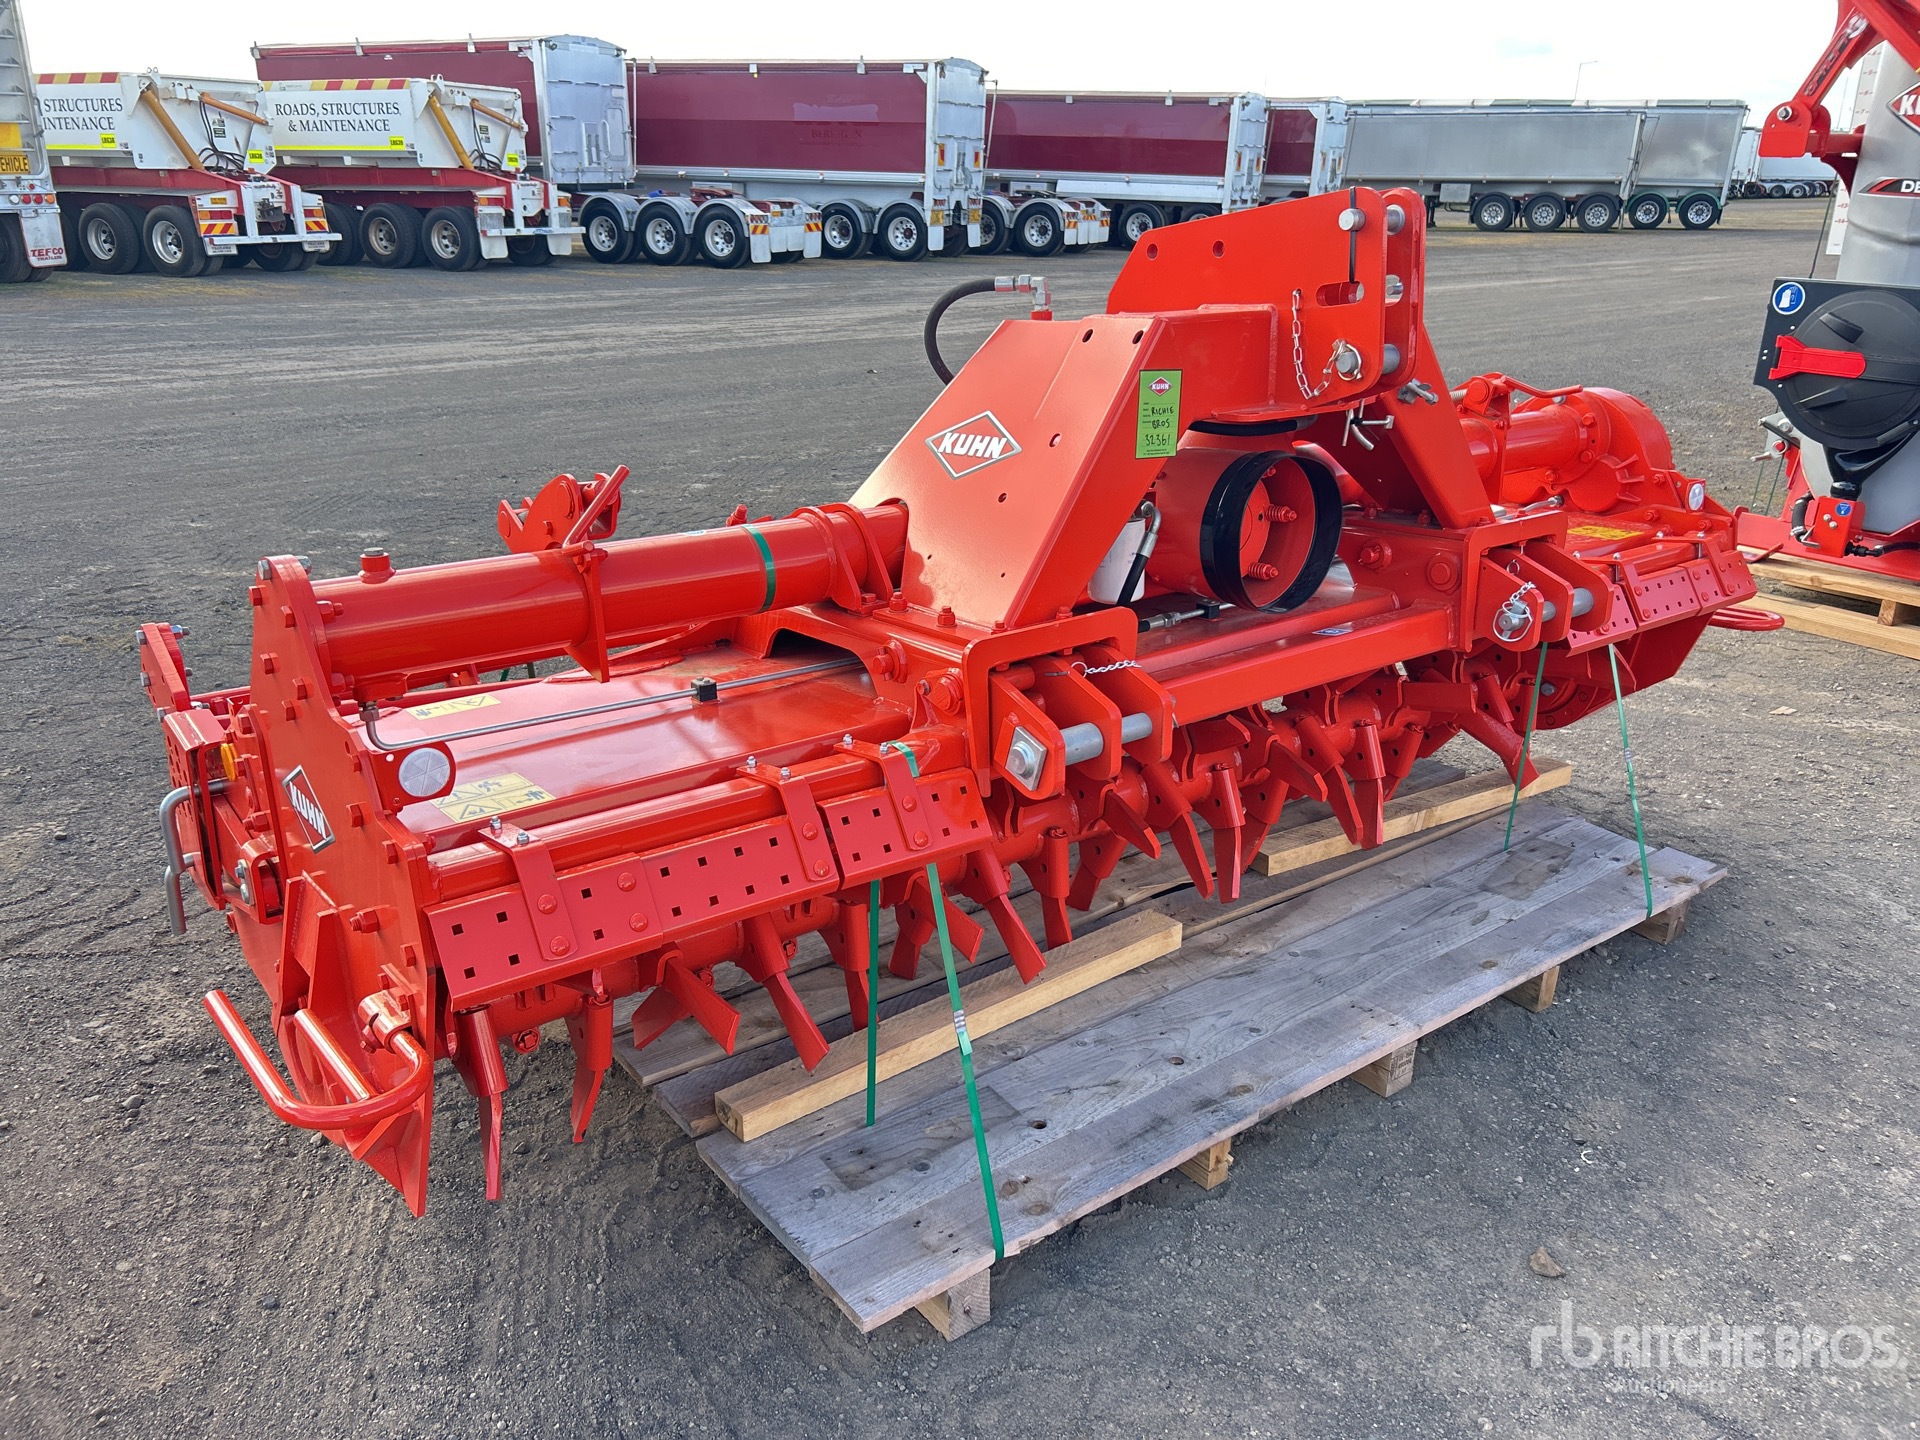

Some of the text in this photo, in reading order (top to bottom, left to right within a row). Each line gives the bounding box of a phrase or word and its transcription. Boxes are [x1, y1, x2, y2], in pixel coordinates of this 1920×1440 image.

[44, 98, 123, 112] STRUCTURES
[274, 103, 320, 117] ROADS,
[288, 119, 391, 132] & MAINTENANCE
[30, 247, 64, 258] TEFCO
[1151, 406, 1175, 416] RICHIE
[1151, 418, 1171, 430] BROS
[937, 431, 1008, 460] KUHN
[1144, 433, 1171, 447] 32361
[288, 780, 327, 840] KUHN
